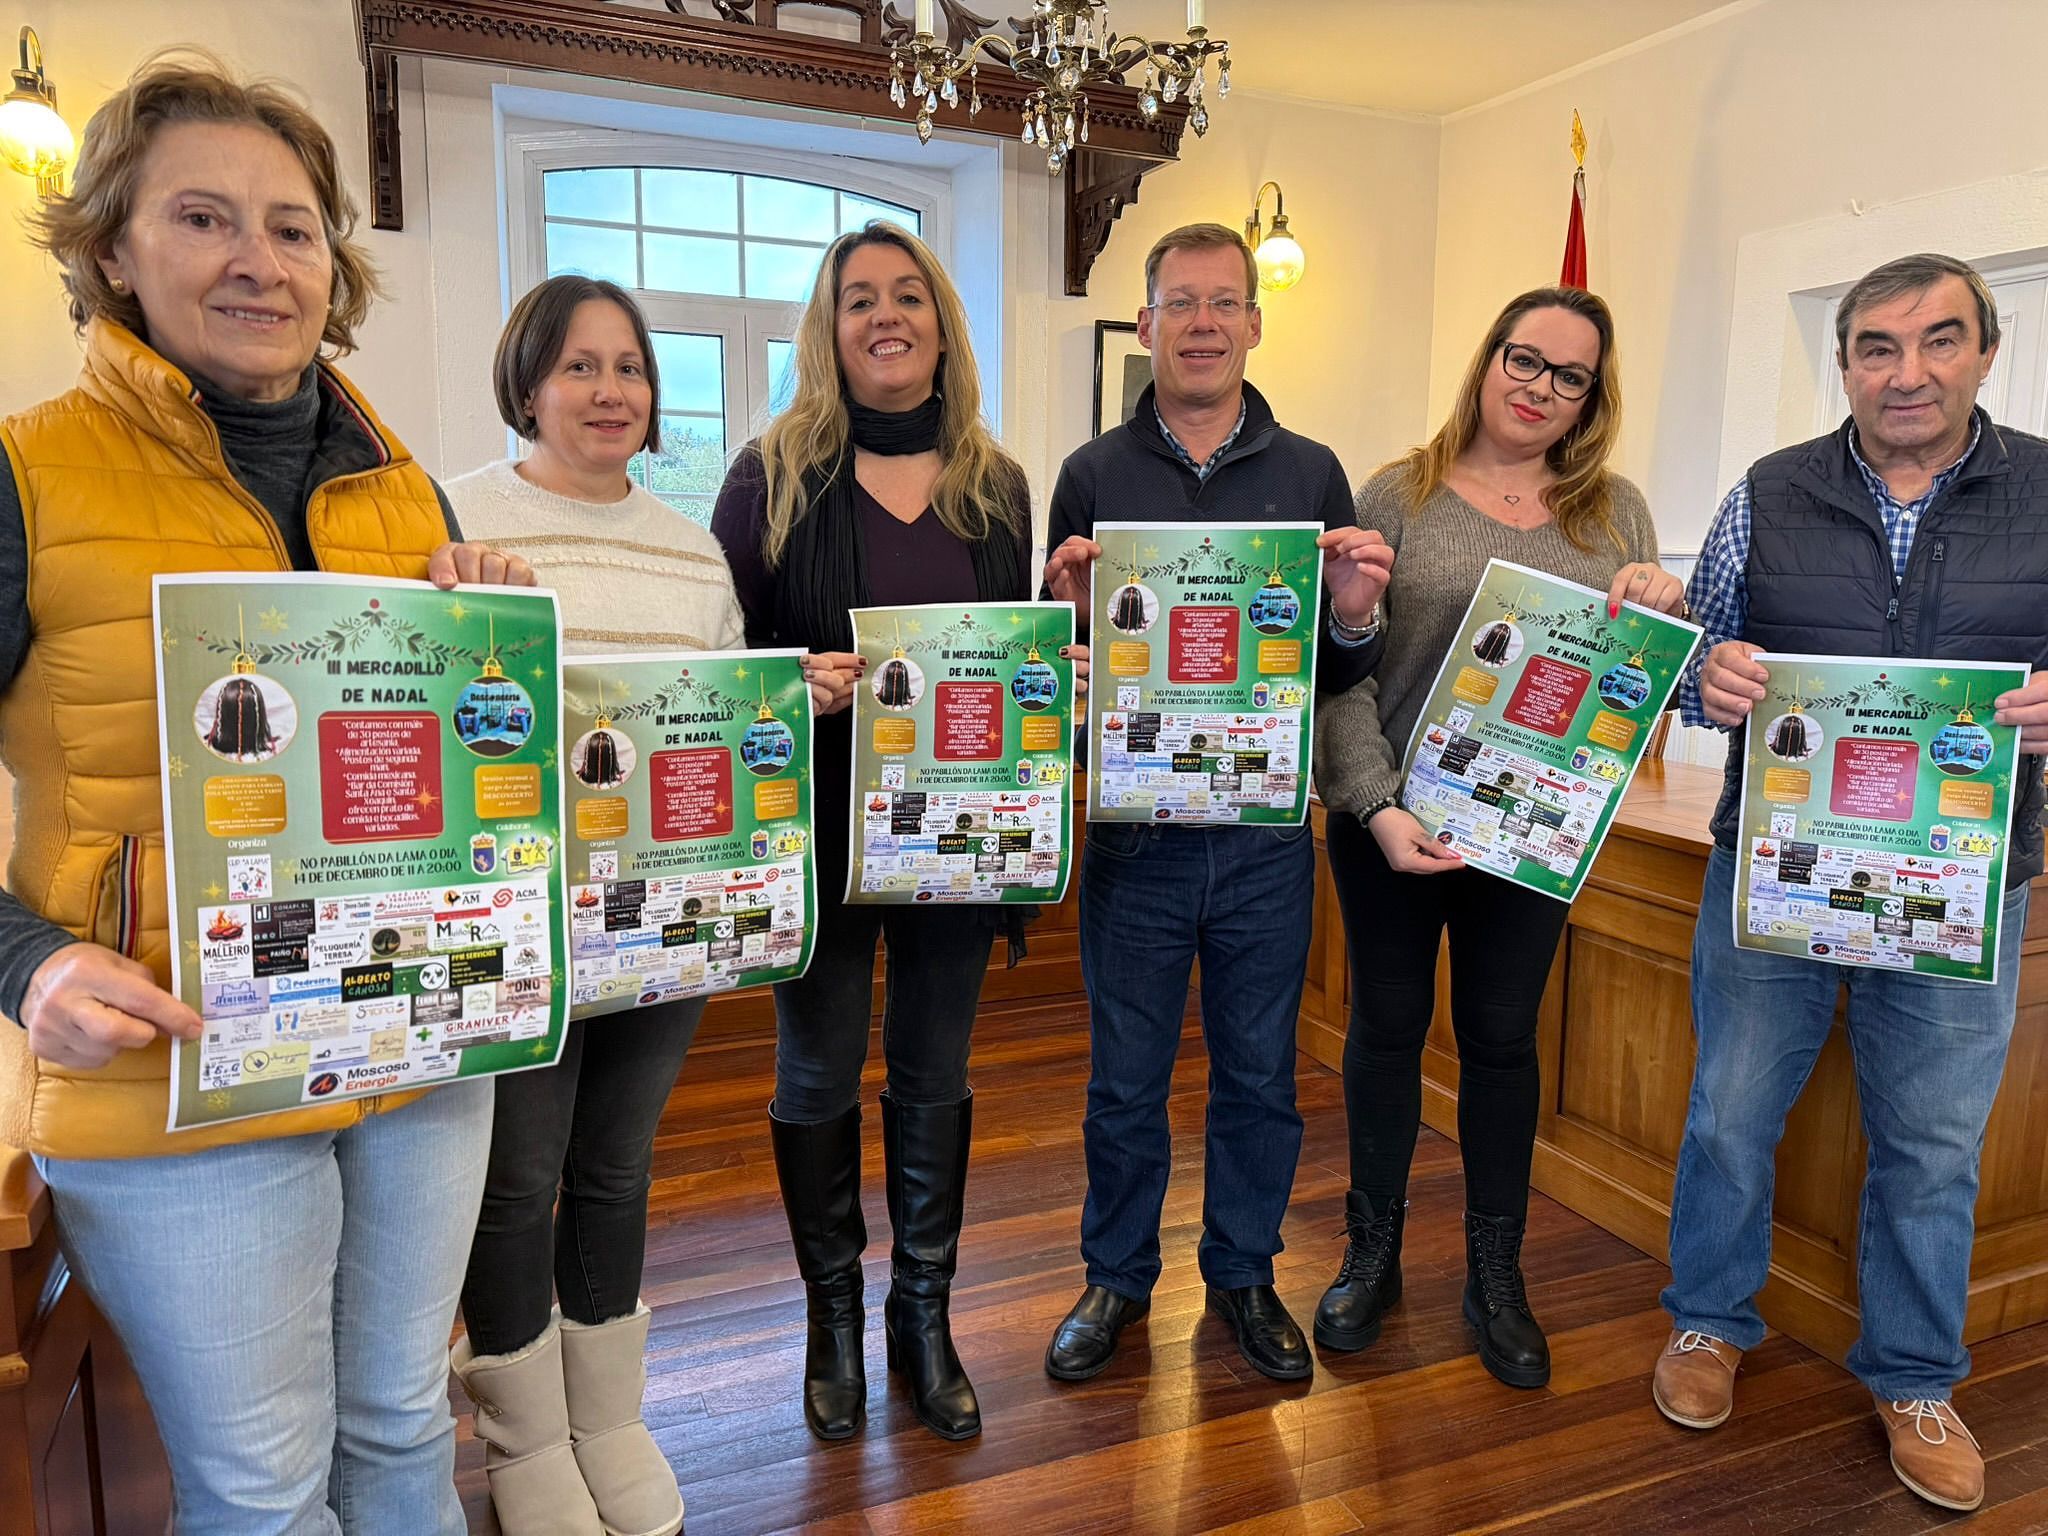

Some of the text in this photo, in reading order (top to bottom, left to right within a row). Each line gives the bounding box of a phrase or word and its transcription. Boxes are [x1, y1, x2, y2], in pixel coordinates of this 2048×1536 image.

[1177, 575, 1246, 584] III MERCADILLO
[1184, 592, 1234, 602] DE NADAL
[1548, 628, 1610, 655] III MERCADILLO
[942, 650, 1008, 660] III MERCADILLO
[1547, 645, 1592, 666] DE NADAL
[327, 660, 446, 676] III MERCADILLO
[949, 666, 997, 676] DE NADAL
[342, 688, 428, 703] DE NADAL
[656, 710, 734, 726] III MERCADILLO
[1846, 708, 1928, 720] III MERCADILLO
[665, 731, 722, 744] DE NADAL
[1852, 724, 1912, 737] DE NADAL
[1812, 820, 1824, 828] NO
[1862, 824, 1873, 832] DA
[1874, 826, 1896, 835] LAMA
[1898, 829, 1904, 837] O
[228, 838, 266, 850] Organiza
[1456, 835, 1491, 854] Moscoso
[1816, 828, 1826, 836] DE
[1828, 829, 1868, 840] DECEMBRO
[1870, 834, 1880, 842] DE
[1888, 836, 1894, 844] A
[1894, 837, 1921, 846] 20:00
[637, 852, 648, 860] NO
[688, 846, 699, 854] DA
[700, 844, 721, 853] LAMA
[642, 861, 651, 869] DE
[653, 856, 695, 868] DECEMBRO
[721, 850, 745, 860] 20:00
[300, 858, 318, 870] NO
[320, 852, 376, 868] PABILLÓN
[378, 852, 394, 864] DA
[396, 850, 426, 862] LAMA
[430, 850, 438, 860] O
[1918, 861, 1932, 870] AM
[294, 872, 306, 884] 14
[309, 871, 324, 883] DE
[326, 866, 388, 881] DECEMBRO
[391, 866, 405, 876] DE
[417, 864, 425, 874] A
[426, 860, 461, 874] 20:00
[744, 872, 757, 881] AM
[1961, 867, 1979, 875] ACM
[462, 894, 480, 904] AM
[516, 889, 537, 898] ACM
[204, 944, 250, 960] MALLEIRO
[314, 940, 361, 952] PELUQUERÍA
[1834, 944, 1877, 957] Moscoso
[324, 952, 352, 960] TERESA
[344, 972, 391, 987] ALBERTO
[445, 1015, 510, 1033] GRANIVER
[347, 1062, 410, 1080] Moscoso
[345, 1074, 398, 1091] Energía
